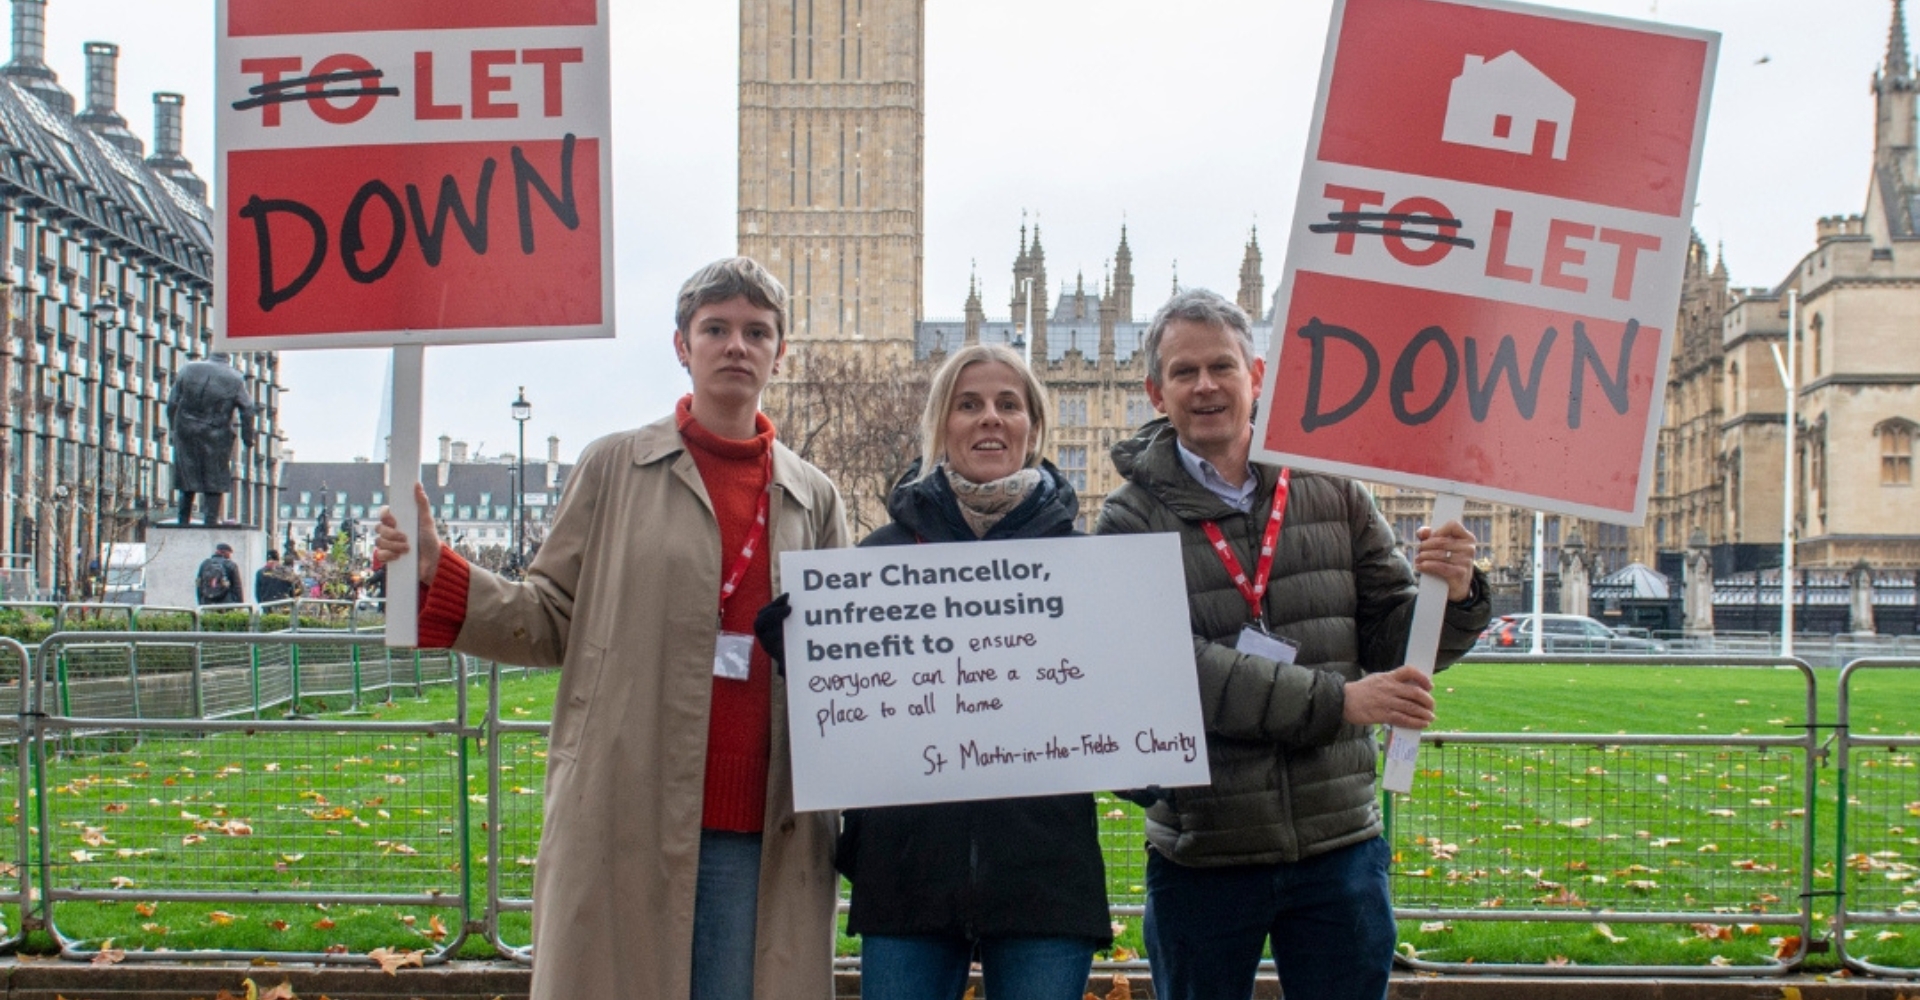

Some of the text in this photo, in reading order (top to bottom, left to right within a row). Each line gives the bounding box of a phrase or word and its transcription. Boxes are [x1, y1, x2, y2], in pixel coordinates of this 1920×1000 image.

[241, 47, 583, 127] TO LET
[239, 133, 580, 312] DOWN
[1323, 183, 1662, 301] TO LET
[1297, 316, 1640, 433] DOWN
[803, 559, 1051, 591] Dear Chancellor,
[805, 593, 1064, 626] unfreeze housing
[807, 633, 1037, 662] benefit to ensure
[809, 657, 1084, 697] everyone can have a safe
[816, 692, 1003, 738] place to call home
[923, 745, 948, 776] St
[1135, 728, 1197, 763] Charity
